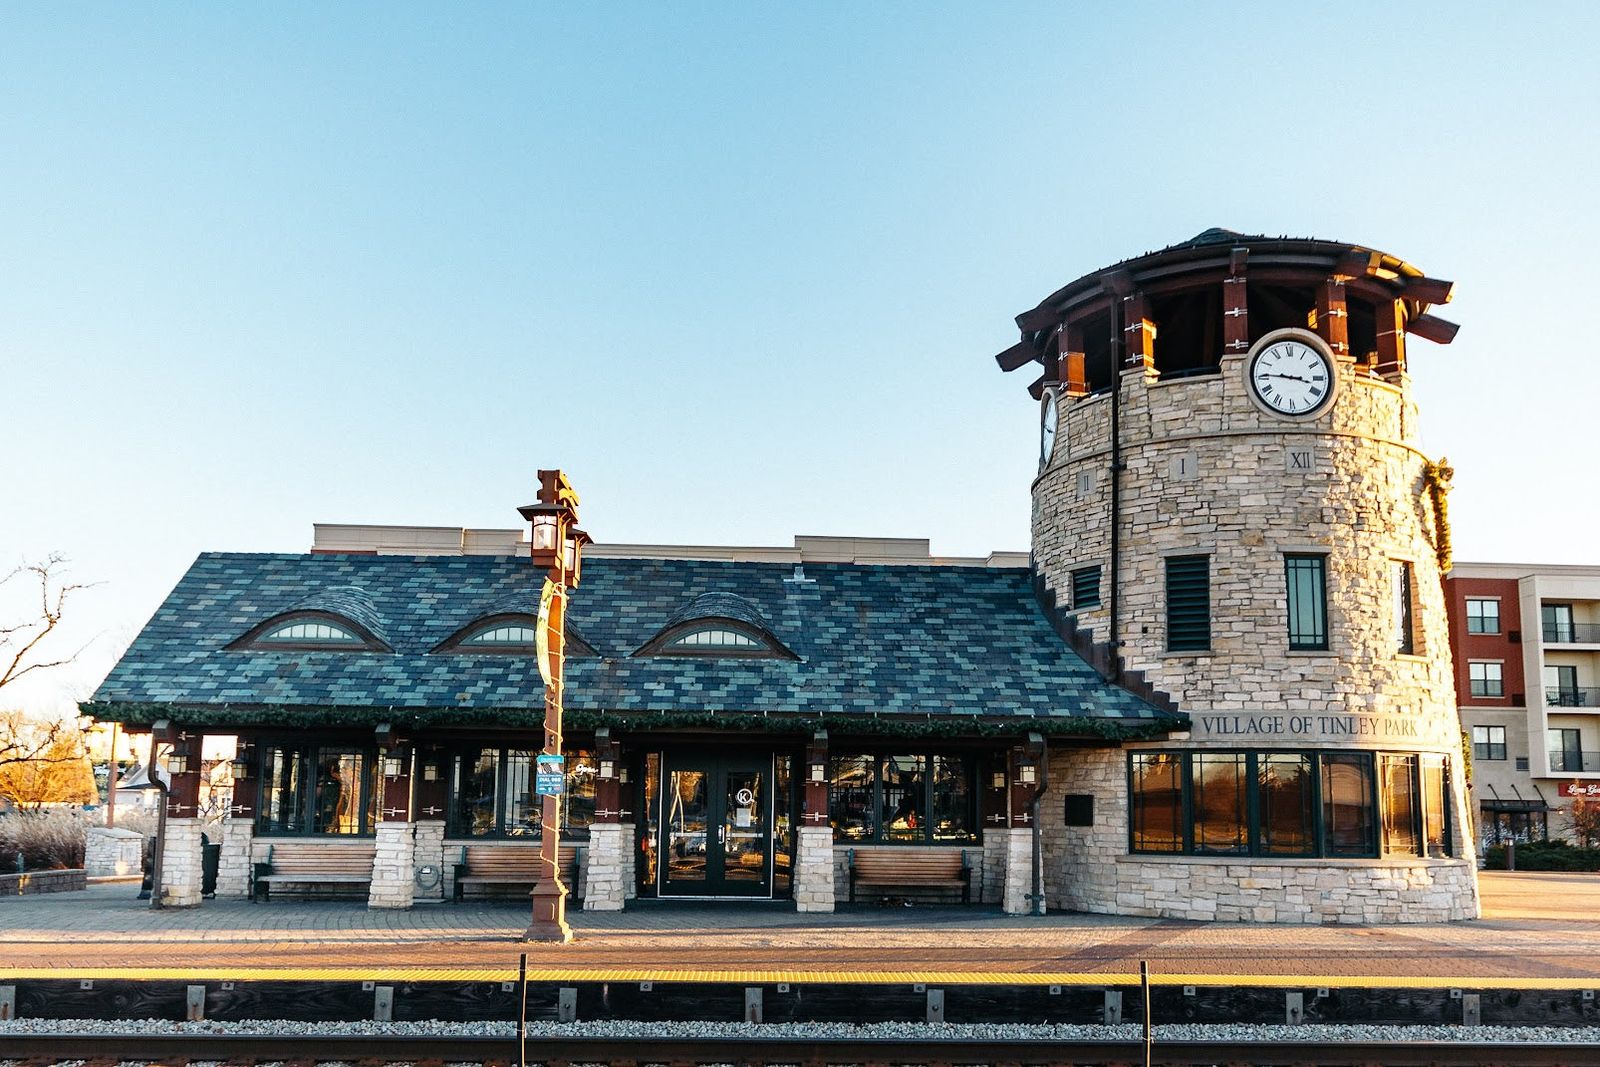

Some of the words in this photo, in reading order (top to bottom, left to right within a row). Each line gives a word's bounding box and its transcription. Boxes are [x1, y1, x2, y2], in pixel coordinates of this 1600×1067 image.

[1291, 452, 1310, 469] XII
[1202, 716, 1284, 734] VILLAGE
[1289, 716, 1313, 734] OF
[1317, 716, 1380, 736] TINLEY
[1384, 720, 1418, 737] PARK
